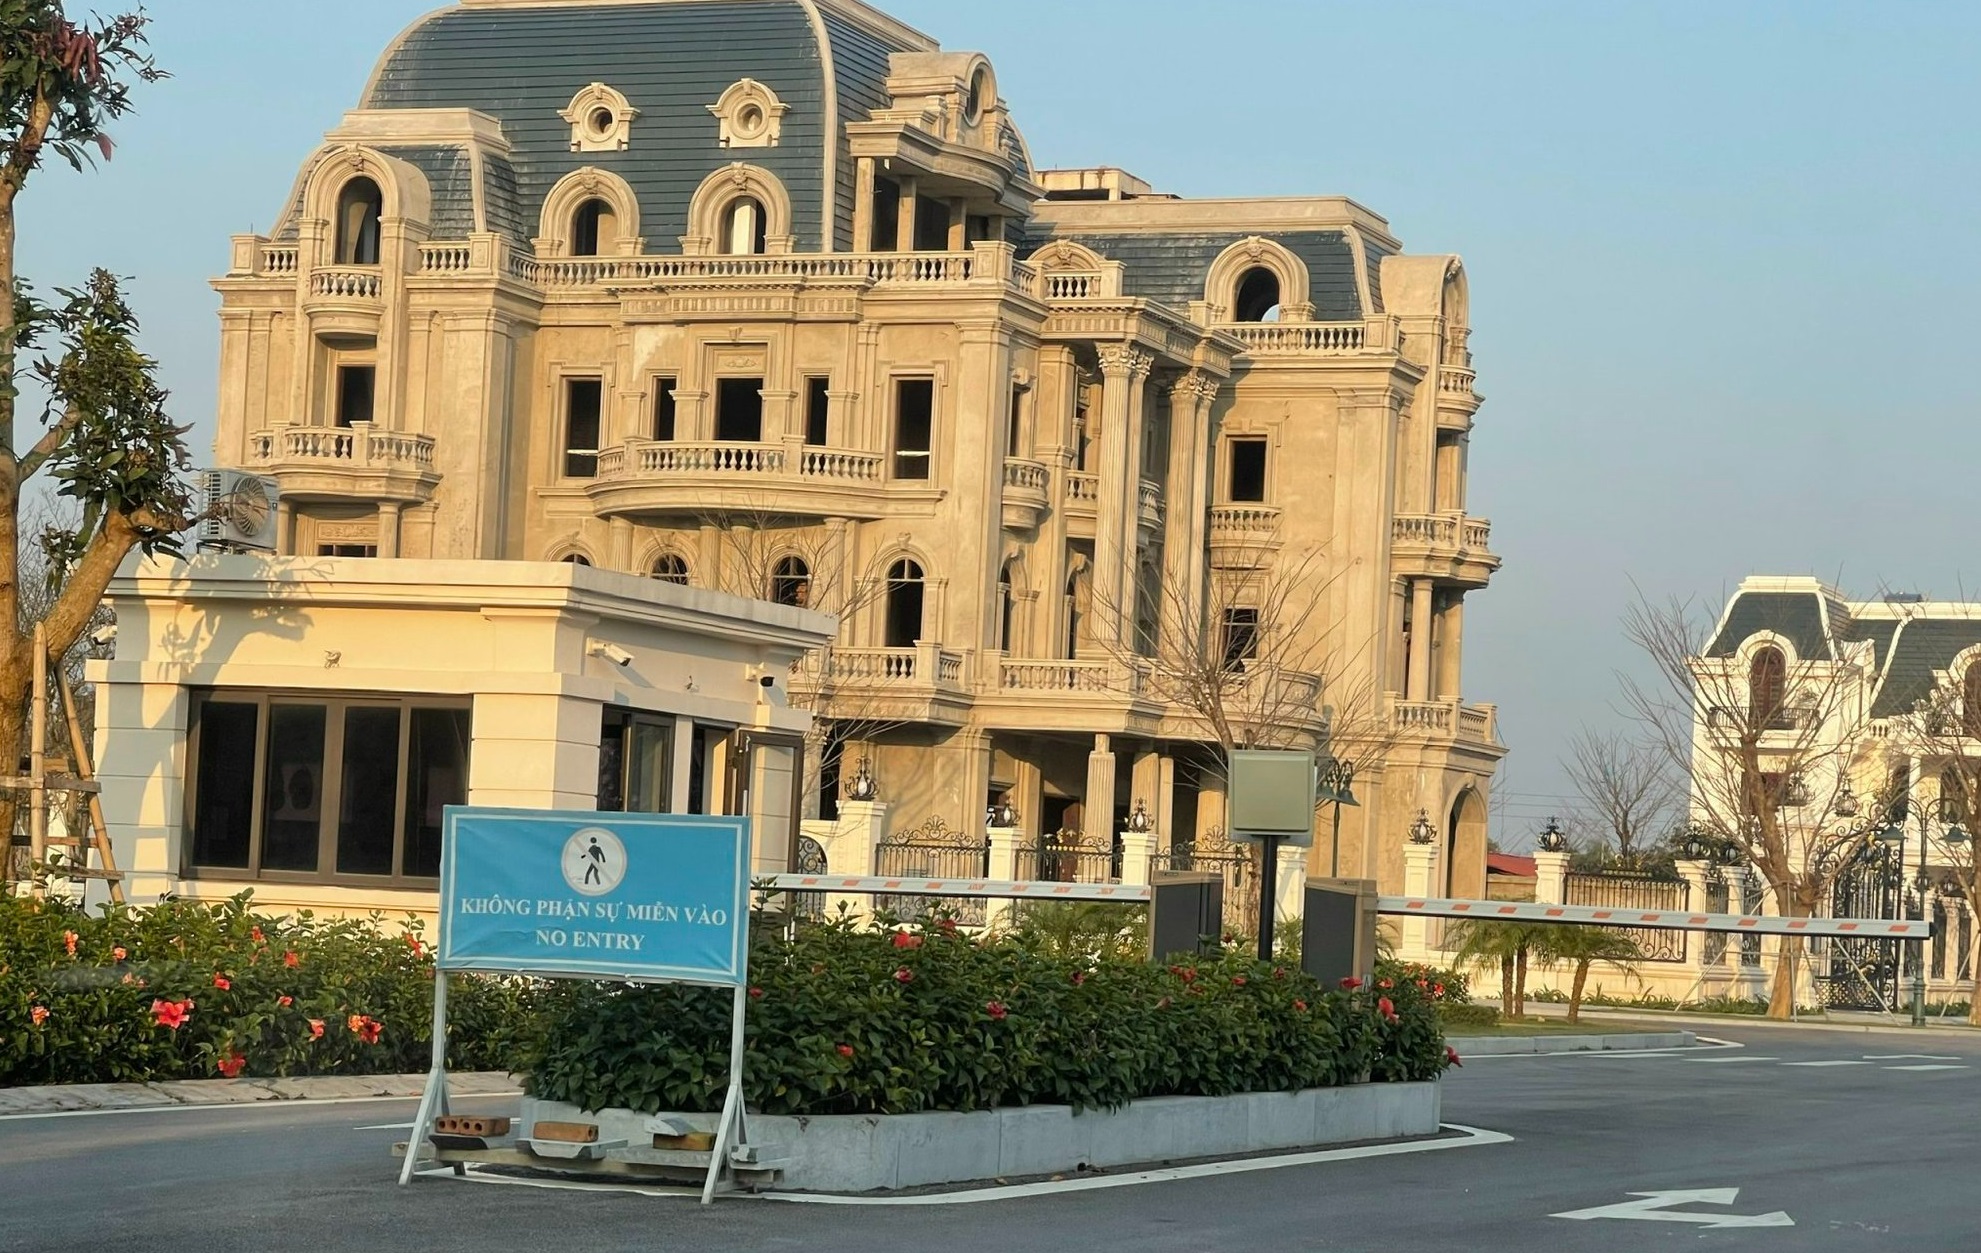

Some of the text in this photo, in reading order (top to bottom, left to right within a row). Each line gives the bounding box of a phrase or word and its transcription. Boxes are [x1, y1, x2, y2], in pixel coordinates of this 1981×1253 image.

[461, 893, 531, 915] KHÔNG
[594, 901, 623, 923] SỰ
[683, 903, 727, 926] VÀO
[536, 929, 645, 950] NO ENTRY
